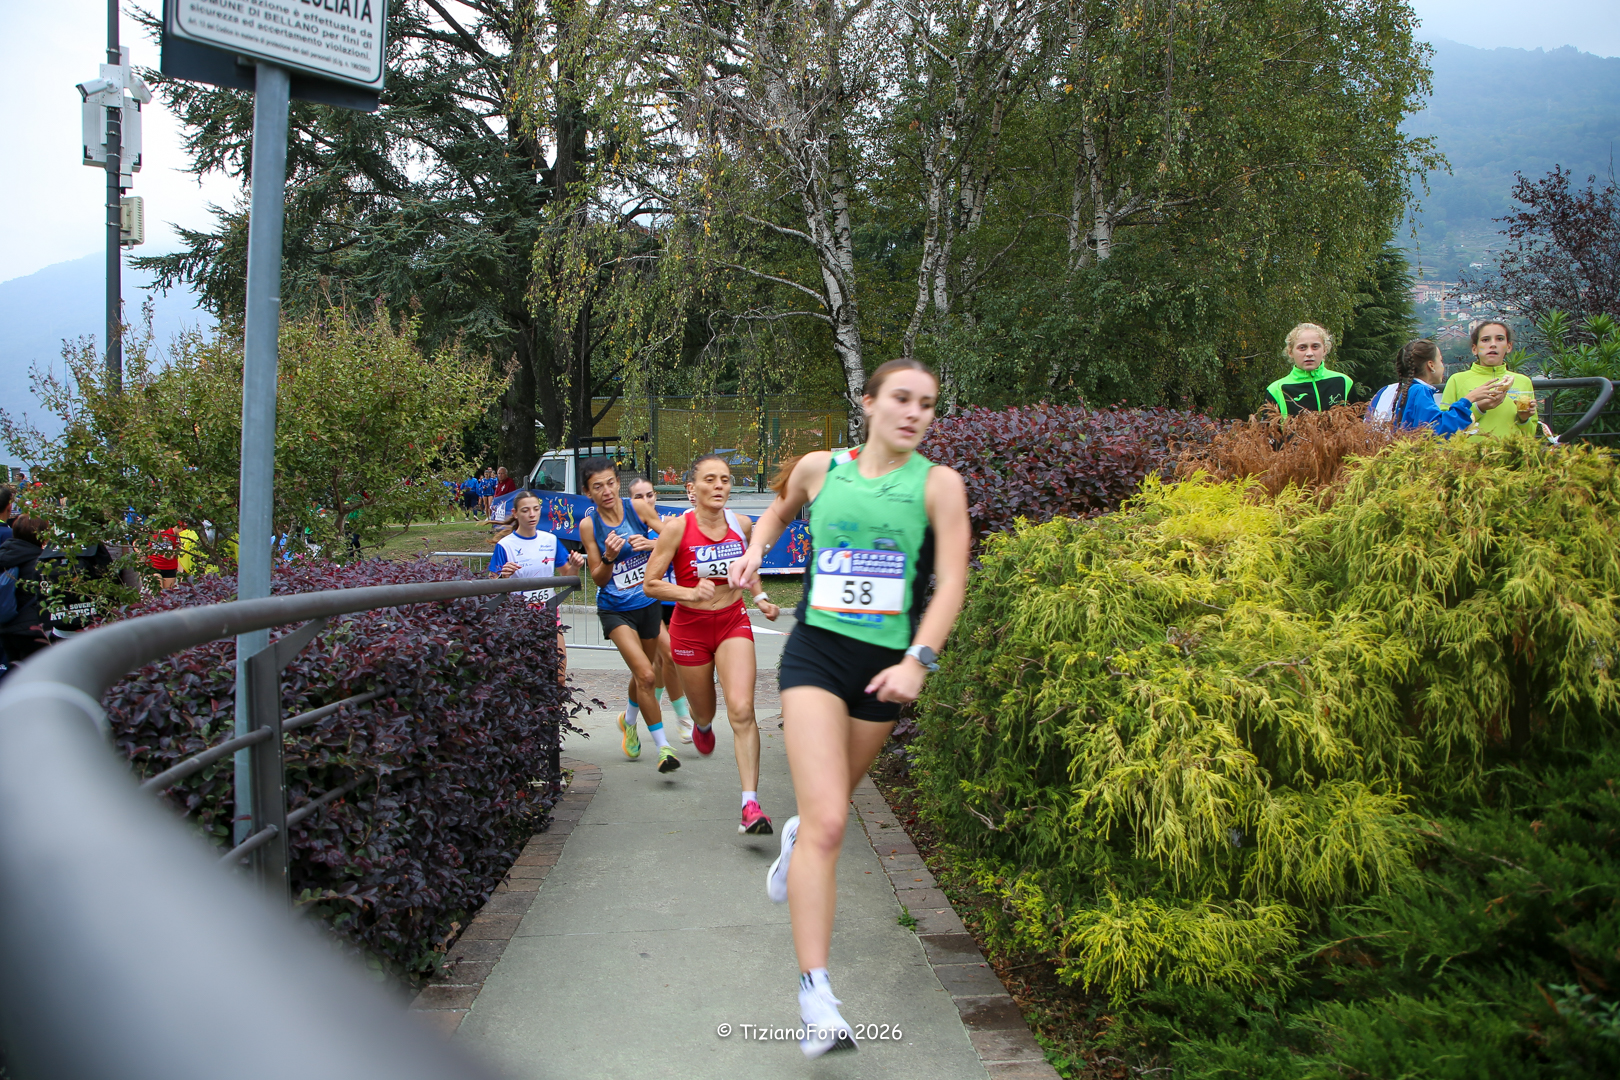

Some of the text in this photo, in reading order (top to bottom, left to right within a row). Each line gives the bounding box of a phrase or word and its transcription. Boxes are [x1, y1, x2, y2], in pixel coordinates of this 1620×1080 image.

[189, 3, 372, 61] sicurezza ed accertamento violazioni.
[248, 6, 260, 17] DI
[264, 11, 319, 35] BELLANO
[322, 30, 339, 40] per
[343, 34, 360, 47] fini
[363, 41, 373, 50] di
[293, 7, 300, 17] è
[303, 13, 357, 34] effettuata
[360, 28, 373, 39] da
[624, 567, 645, 584] 445
[709, 560, 735, 576] 33
[530, 590, 549, 602] 565
[842, 580, 873, 605] 58
[69, 602, 96, 610] SOVER
